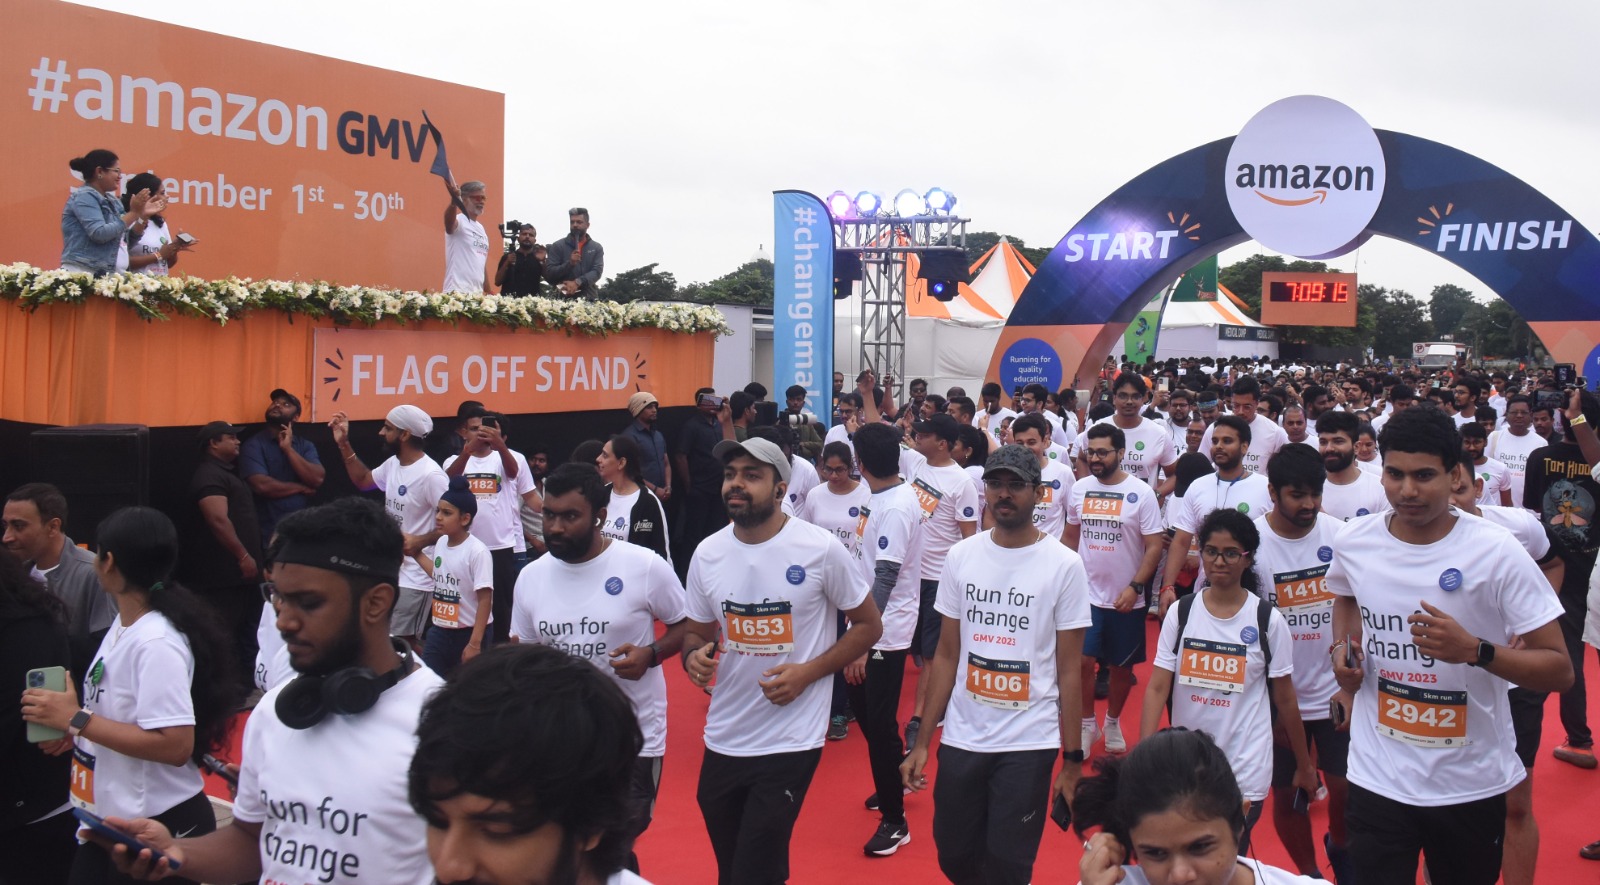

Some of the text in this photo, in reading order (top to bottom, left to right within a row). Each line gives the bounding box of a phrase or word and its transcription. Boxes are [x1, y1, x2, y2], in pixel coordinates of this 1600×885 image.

[28, 57, 428, 163] #amazon GMV
[1235, 162, 1374, 193] amazon
[70, 169, 272, 211] ember
[354, 190, 404, 221] 30th
[1064, 229, 1179, 263] START
[1436, 219, 1573, 252] FINISH
[1009, 355, 1052, 365] Running for
[1018, 365, 1043, 374] quality
[351, 354, 630, 396] FLAG OFF STAND
[1013, 375, 1048, 383] education
[1087, 499, 1117, 511] 1291
[1082, 527, 1122, 544] change
[446, 573, 461, 586] for
[1283, 578, 1329, 599] 1416
[966, 583, 1035, 608] Run for
[434, 602, 455, 616] 1279
[966, 605, 1030, 633] change
[1361, 605, 1403, 633] Run
[538, 616, 610, 637] Run for
[731, 617, 785, 636] 1653
[1284, 611, 1331, 629] ange
[973, 633, 1016, 646] GMV 2023
[1301, 632, 1321, 641] 2023
[1367, 633, 1435, 668] chang
[1188, 652, 1239, 675] 1108
[971, 669, 1022, 693] 1106
[1380, 669, 1437, 683] GMV 2023
[1191, 694, 1231, 708] GMV 2023
[1386, 684, 1409, 695] amazon
[1423, 692, 1439, 700] 5km
[1385, 698, 1456, 728] 2942
[316, 796, 368, 837] for
